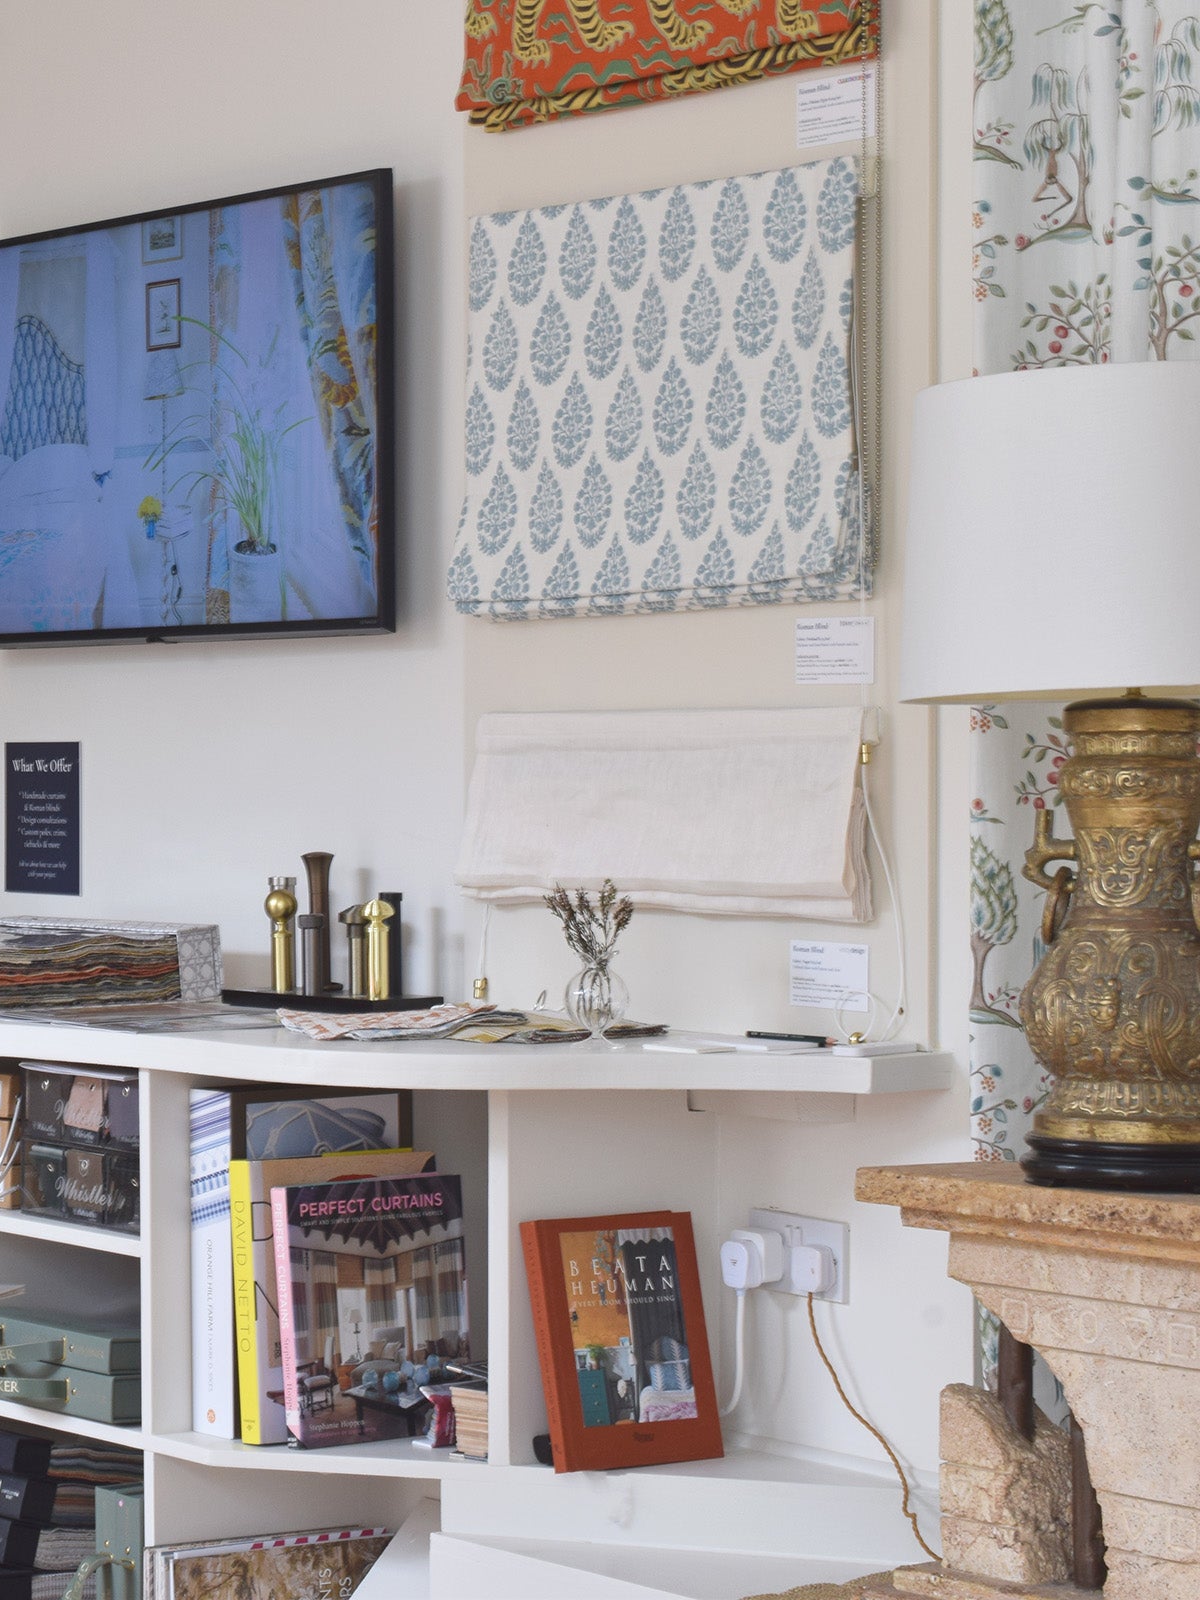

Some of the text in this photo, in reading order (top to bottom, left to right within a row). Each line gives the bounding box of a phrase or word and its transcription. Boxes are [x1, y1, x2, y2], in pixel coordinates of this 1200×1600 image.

[12, 757, 73, 773] What We Offer
[55, 1176, 114, 1207] Whistler
[299, 1192, 443, 1217] PERFECT CURTAINS
[274, 1202, 286, 1260] PERFECT
[318, 1218, 329, 1227] AND
[351, 1215, 378, 1224] SOLUTIONS
[234, 1199, 251, 1353] DAVID NETTO
[570, 1255, 671, 1277] BEATA
[571, 1276, 675, 1296] HEUMAN
[277, 1265, 290, 1330] CURTAINS
[573, 1293, 676, 1309] EVERY ROOM SHOULD SING
[309, 1422, 339, 1433] Stephanie
